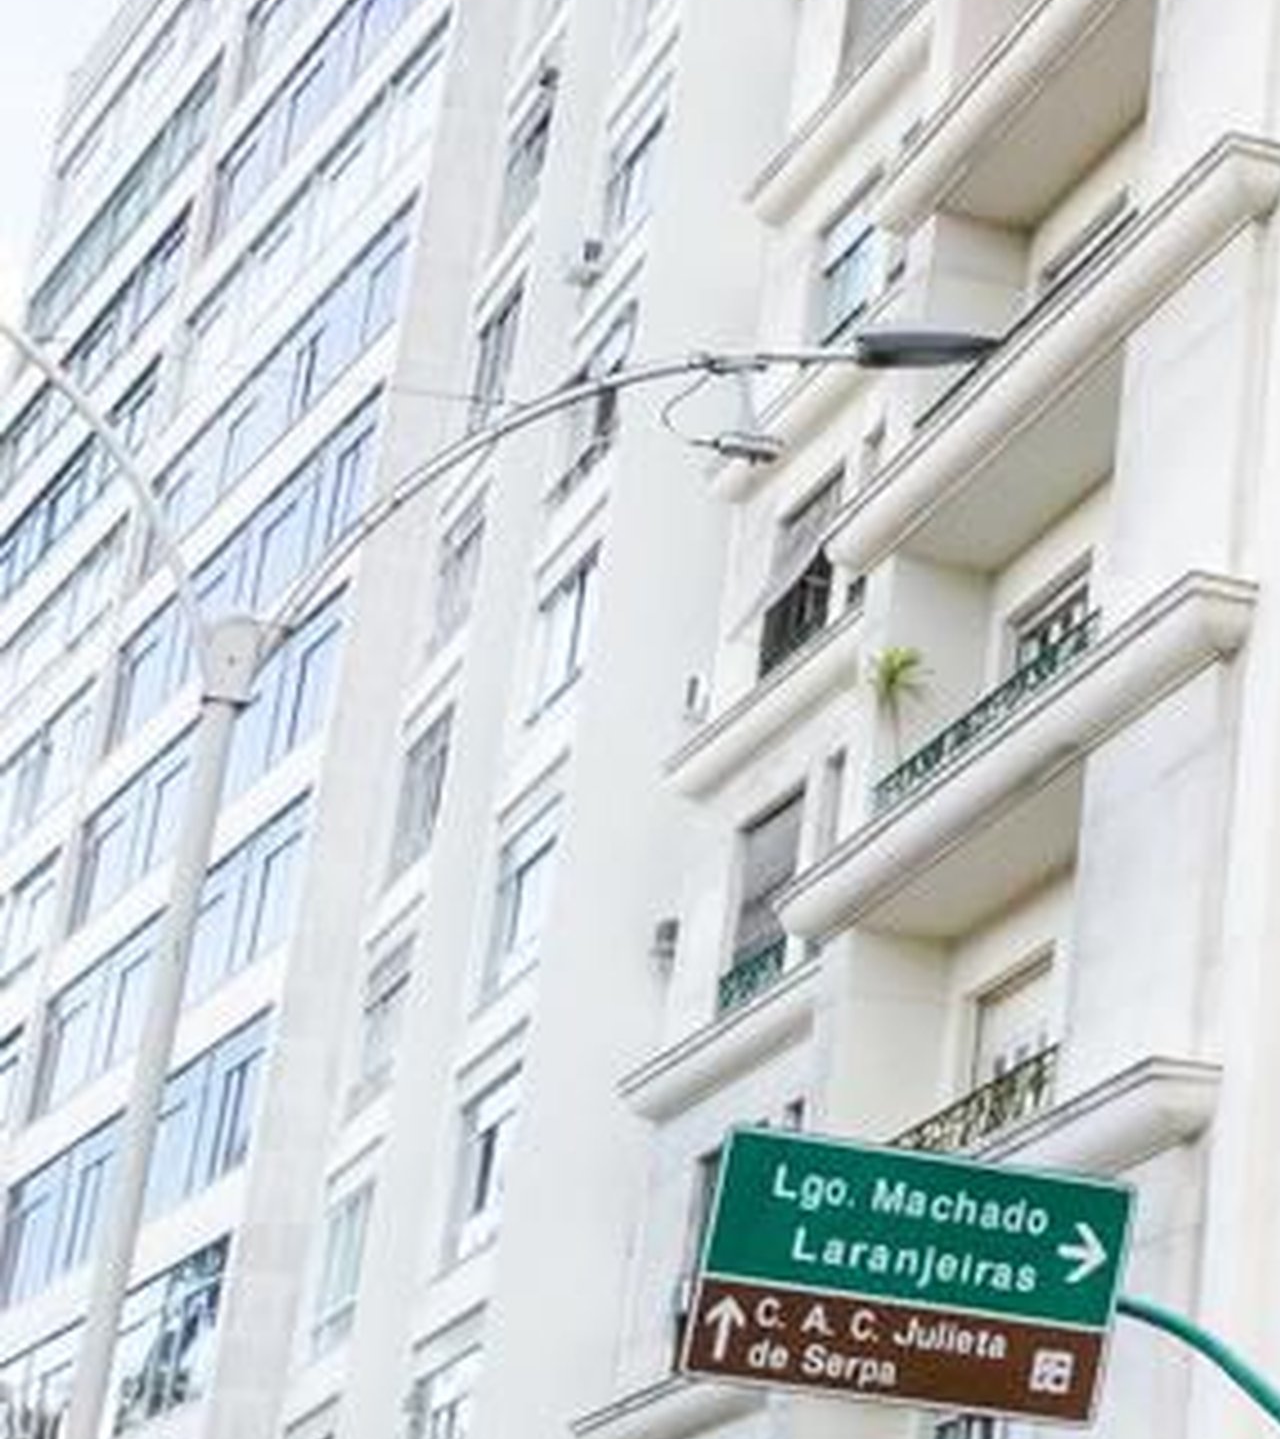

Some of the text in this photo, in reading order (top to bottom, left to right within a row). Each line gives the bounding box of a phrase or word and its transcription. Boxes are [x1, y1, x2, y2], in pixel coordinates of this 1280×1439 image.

[772, 1164, 1049, 1235] Lgo. Machado
[791, 1227, 1038, 1292] Laranjeiras
[747, 1339, 897, 1387] de Serpa
[893, 1318, 1007, 1360] Julieta
